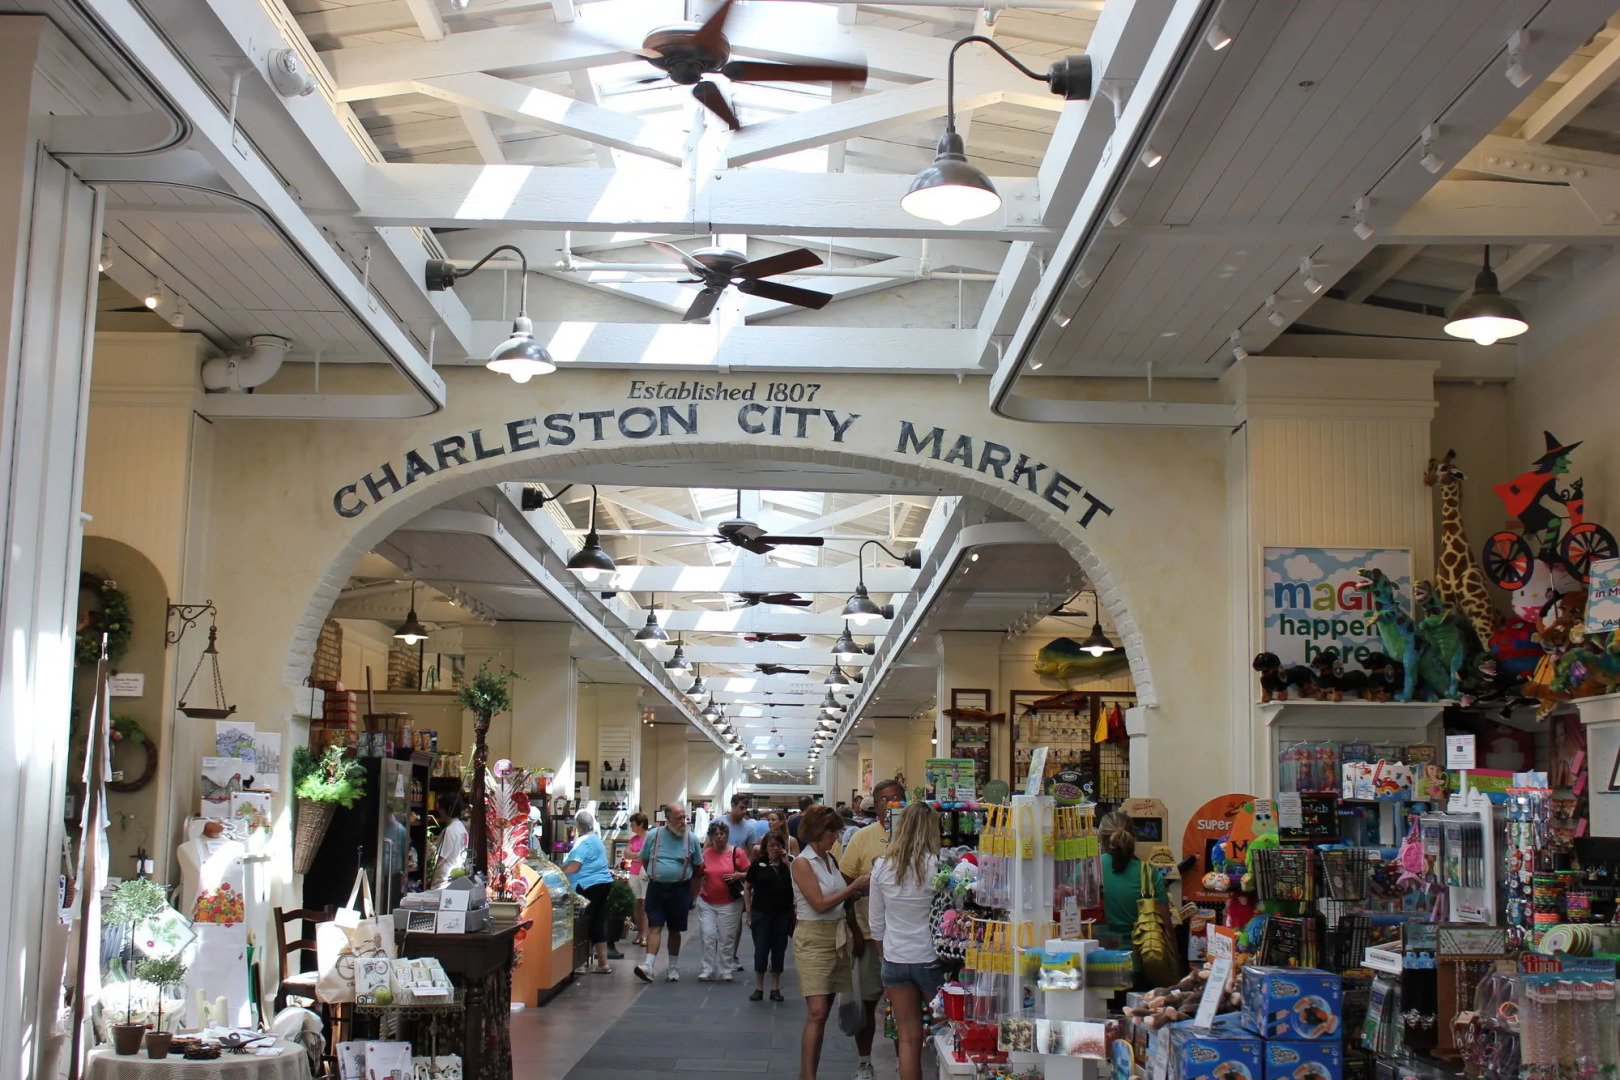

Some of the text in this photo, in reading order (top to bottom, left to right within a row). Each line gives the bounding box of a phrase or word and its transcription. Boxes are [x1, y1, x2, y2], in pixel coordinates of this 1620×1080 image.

[627, 380, 821, 402] Established 1807
[333, 403, 1114, 529] CHARLESTON CITY MARKET
[1280, 614, 1382, 640] happen
